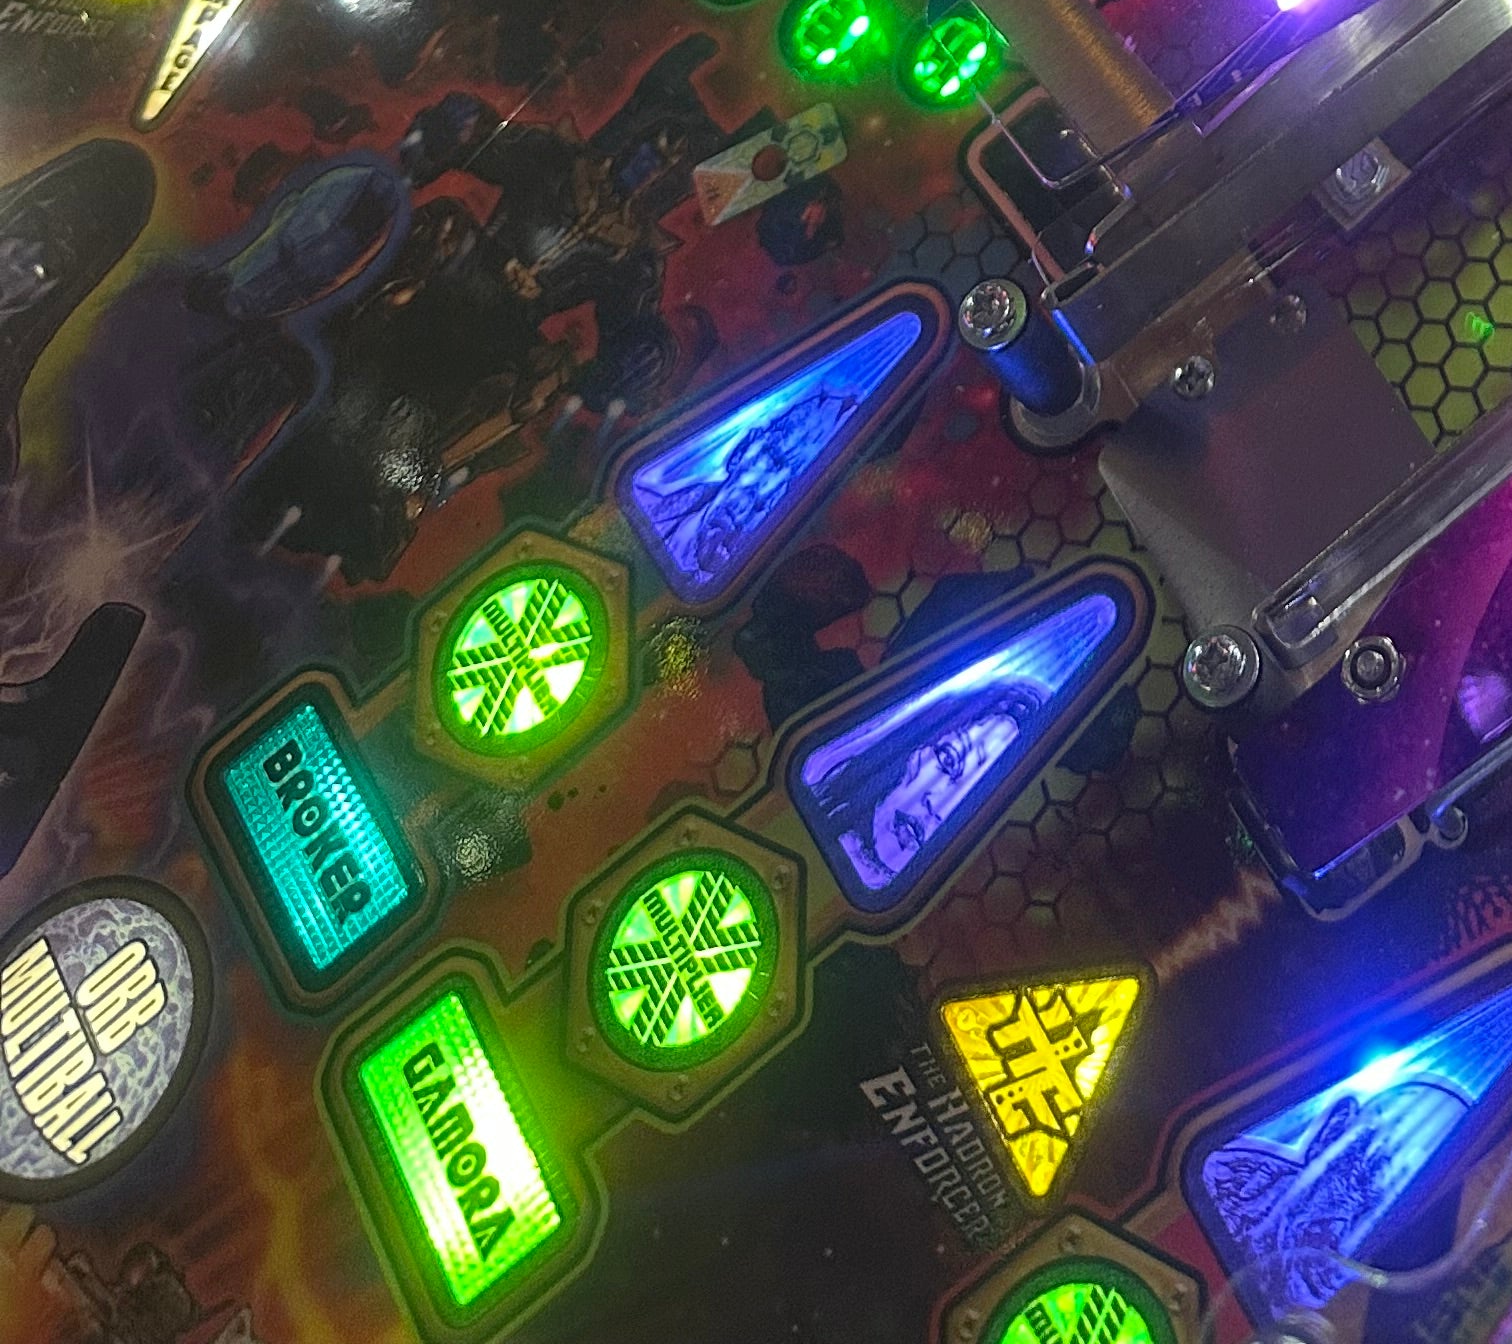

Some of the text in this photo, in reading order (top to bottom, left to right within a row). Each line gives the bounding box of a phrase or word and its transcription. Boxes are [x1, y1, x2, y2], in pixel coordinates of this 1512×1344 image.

[263, 739, 372, 925] BROKER
[76, 939, 167, 1055] ORB
[643, 889, 726, 1028] MULTIPLIER
[0, 936, 123, 1164] MULTIBALL
[910, 1042, 1009, 1210] THE HADRON
[403, 1042, 516, 1262] GAMORA
[860, 1064, 994, 1244] ENFORCER
